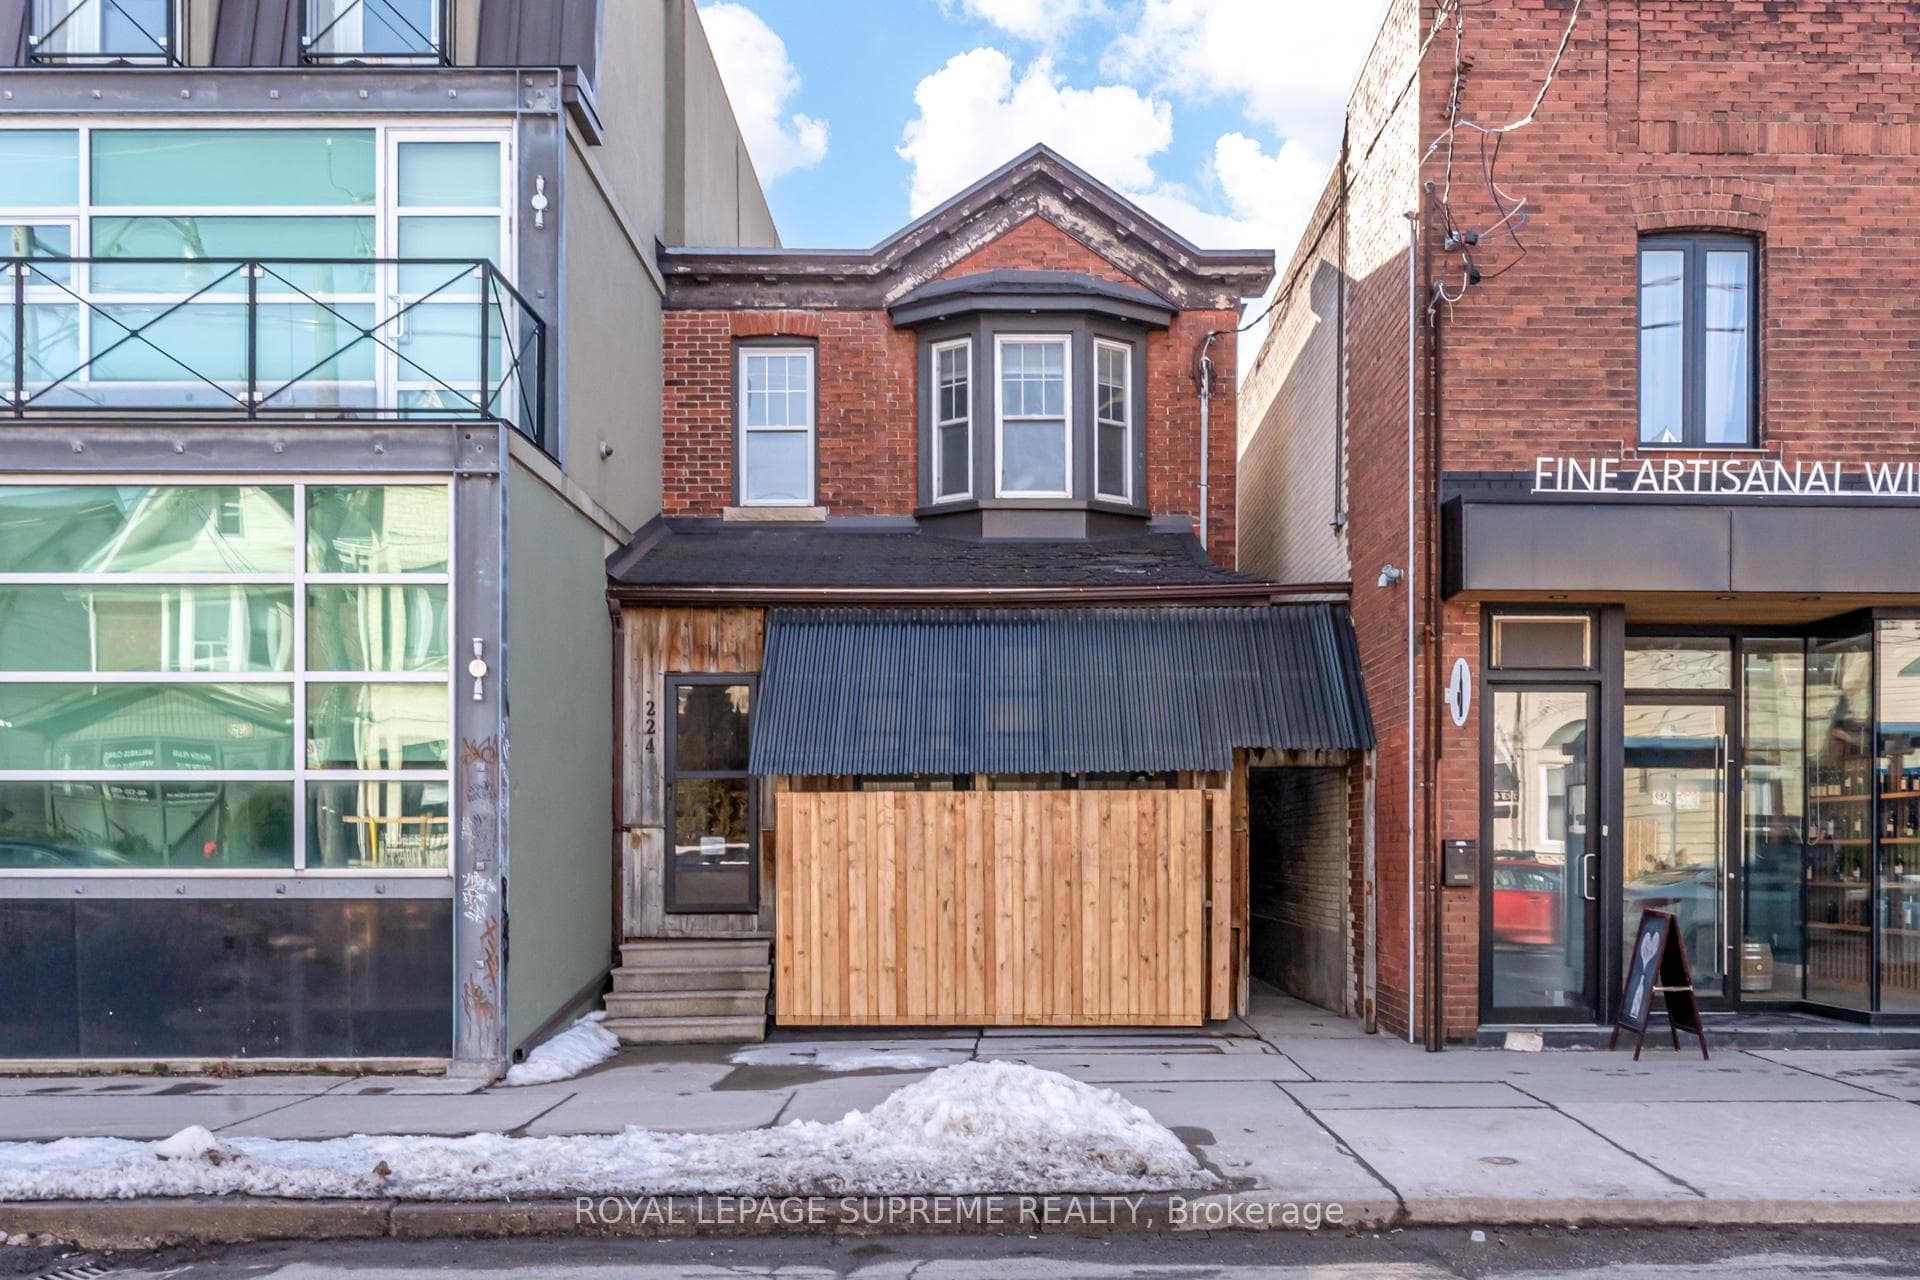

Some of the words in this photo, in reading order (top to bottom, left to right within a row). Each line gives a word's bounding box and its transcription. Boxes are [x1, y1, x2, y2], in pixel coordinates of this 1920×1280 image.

[1535, 457, 1619, 491] FINE
[1633, 458, 1842, 495] ARTISANAL
[1864, 462, 1920, 496] WI
[645, 701, 656, 754] 224
